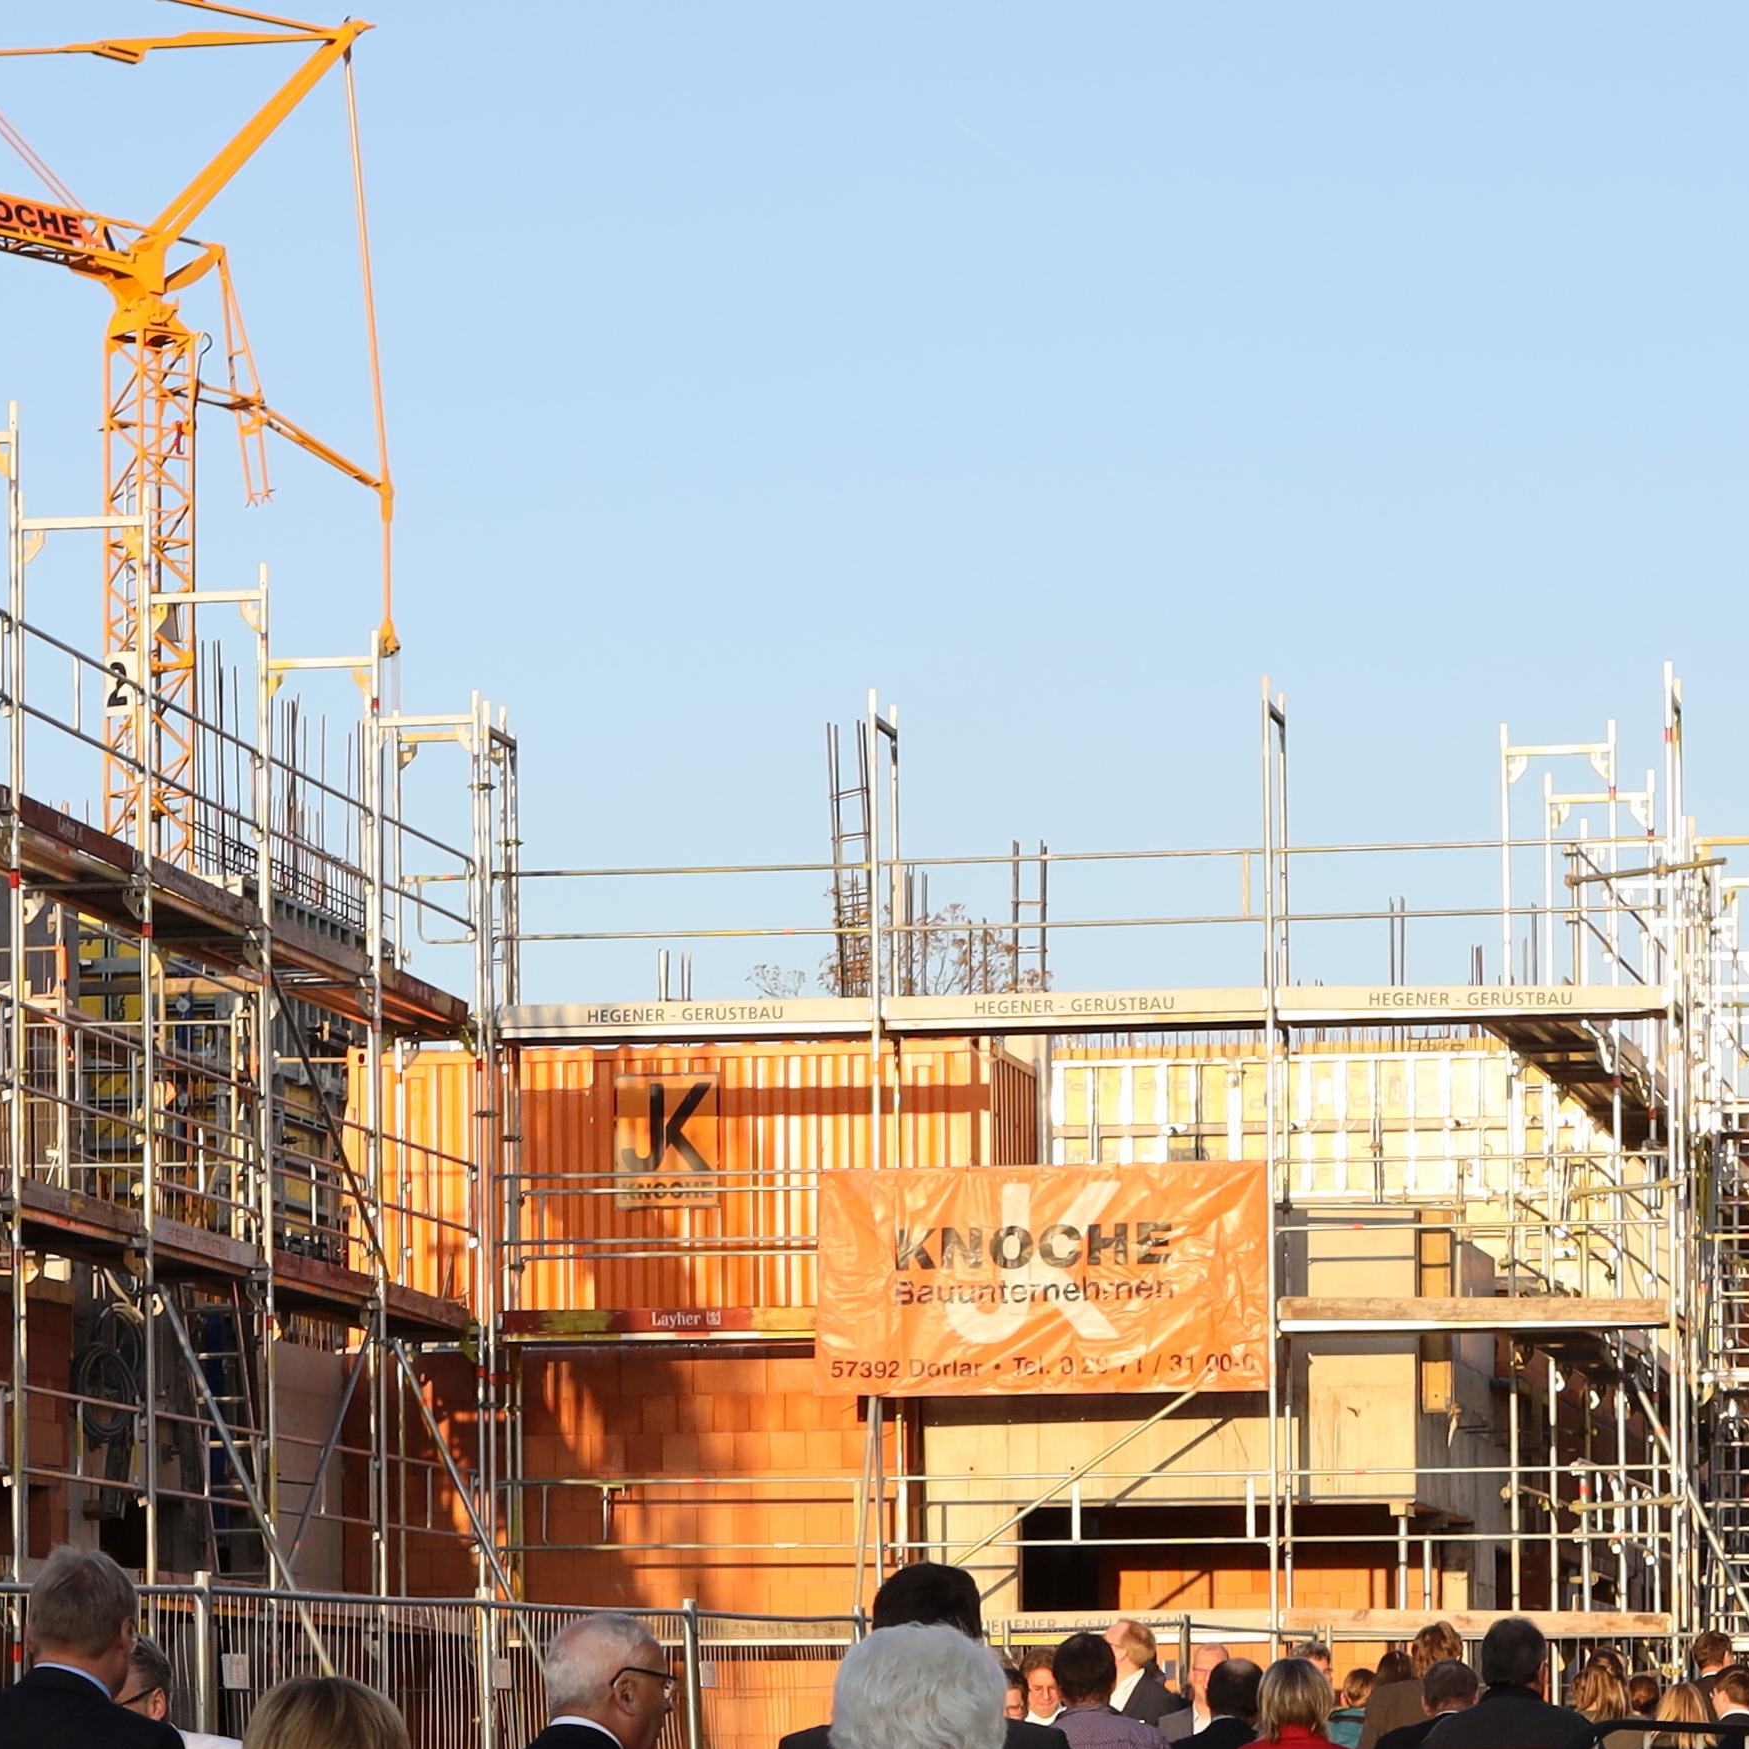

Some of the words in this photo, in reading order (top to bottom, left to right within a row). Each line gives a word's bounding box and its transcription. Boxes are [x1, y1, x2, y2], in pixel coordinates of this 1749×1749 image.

[107, 662, 128, 708] 2
[974, 999, 1054, 1015] HEGENER
[1070, 994, 1175, 1013] GERÜSTBAU
[1368, 991, 1450, 1007] HEGENER
[1466, 987, 1574, 1006] GERÜSTBAU
[587, 1008, 665, 1023] HEGENER
[682, 1003, 784, 1021] GERÜSTBAU
[621, 1082, 713, 1172] JK
[621, 1181, 715, 1201] KNOCHE
[894, 1221, 1173, 1271] KNOCHE
[895, 1276, 1174, 1306] Bauunternehmen
[651, 1311, 701, 1329] Layher
[831, 1360, 900, 1379] 57392
[909, 1358, 983, 1378] Dorlar
[1013, 1356, 1051, 1376] Tel.
[1061, 1355, 1074, 1375] 0
[1081, 1356, 1108, 1375] 29
[1169, 1354, 1195, 1373] 31
[1206, 1353, 1255, 1372] 00-0
